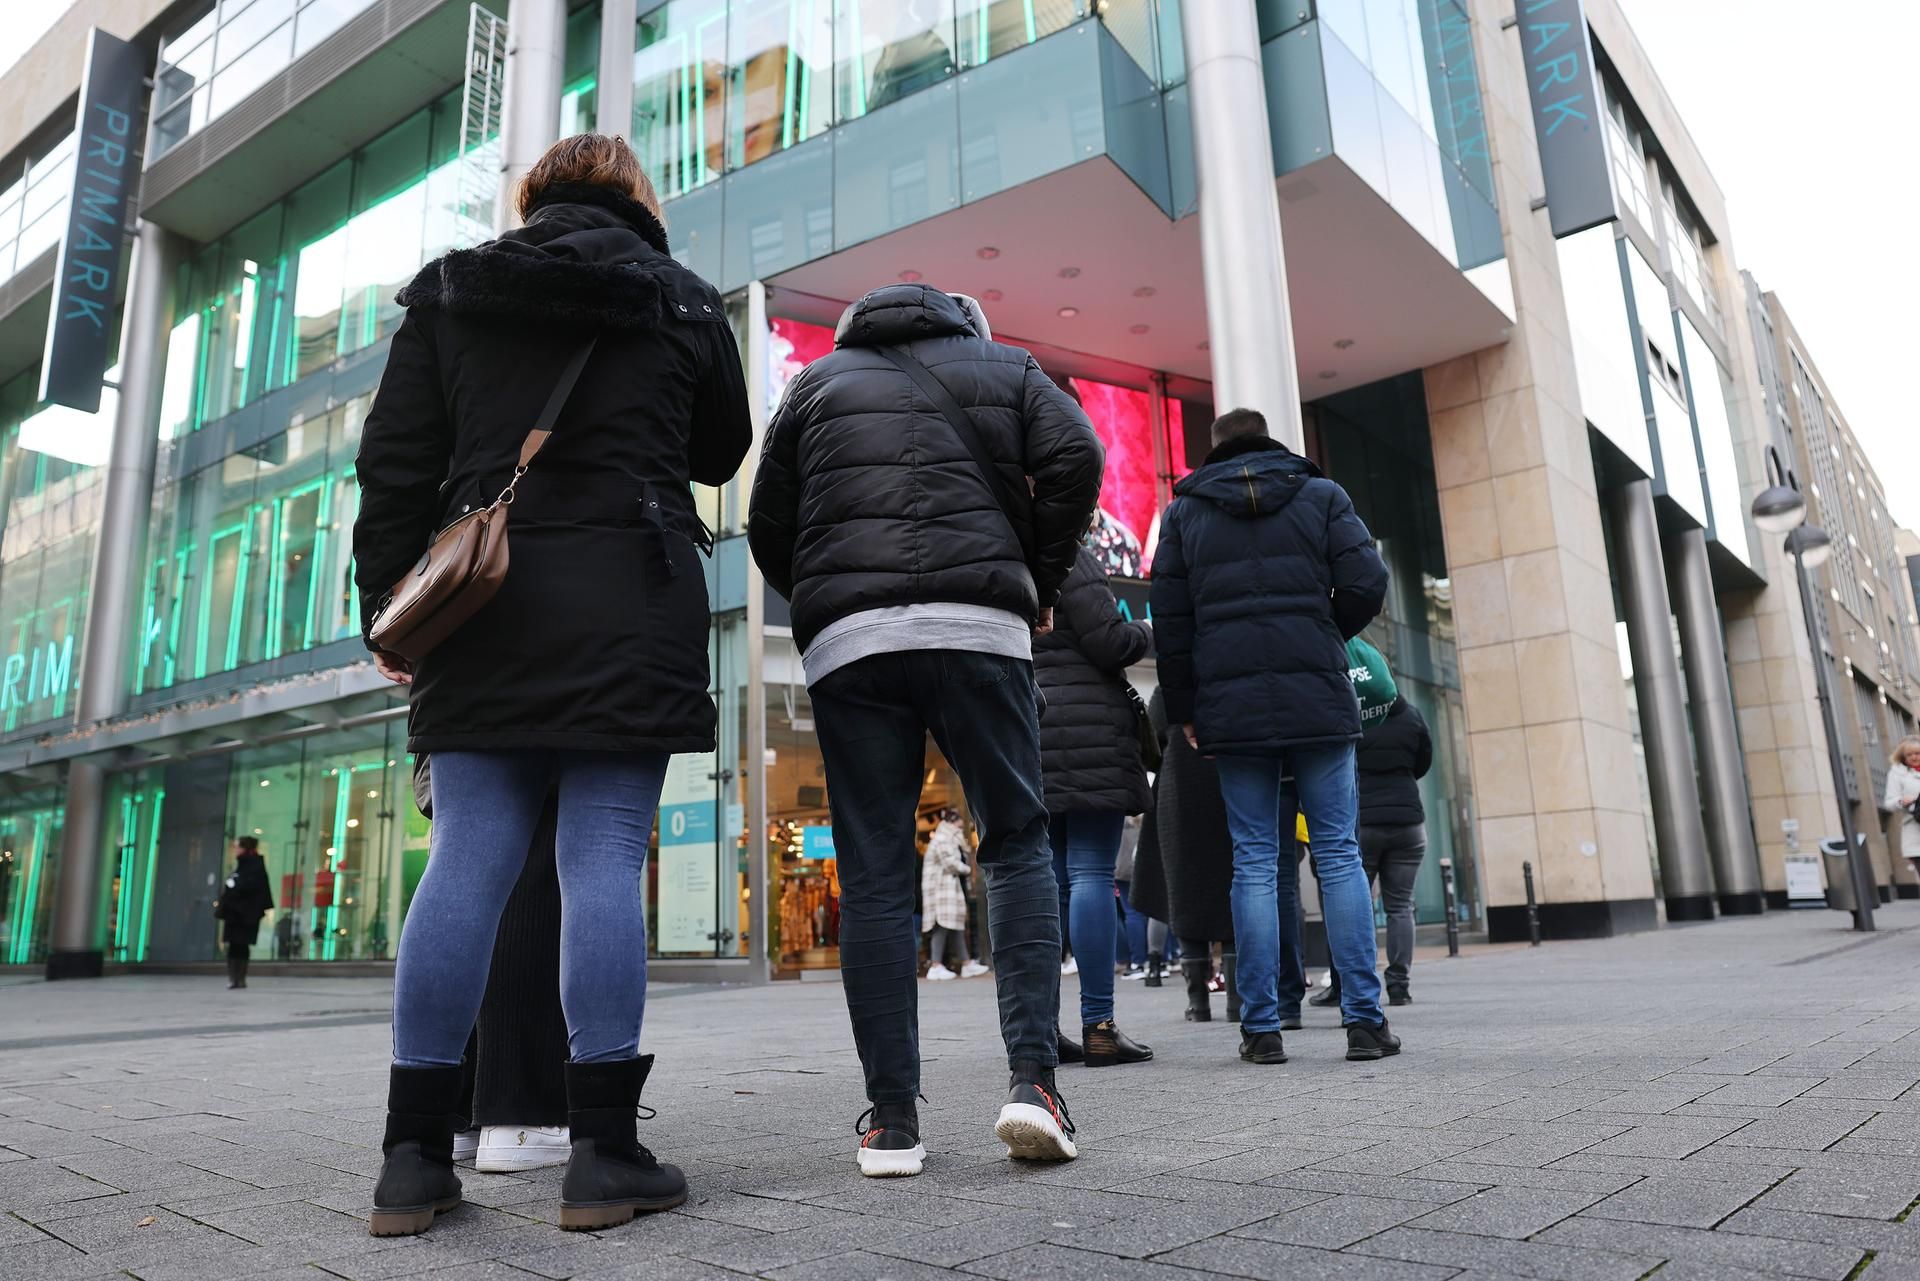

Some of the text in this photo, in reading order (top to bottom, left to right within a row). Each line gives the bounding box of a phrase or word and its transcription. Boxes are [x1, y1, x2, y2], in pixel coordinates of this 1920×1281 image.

[1526, 0, 1588, 136] ARK
[64, 103, 131, 328] PRIMARK
[1347, 666, 1373, 684] PSE
